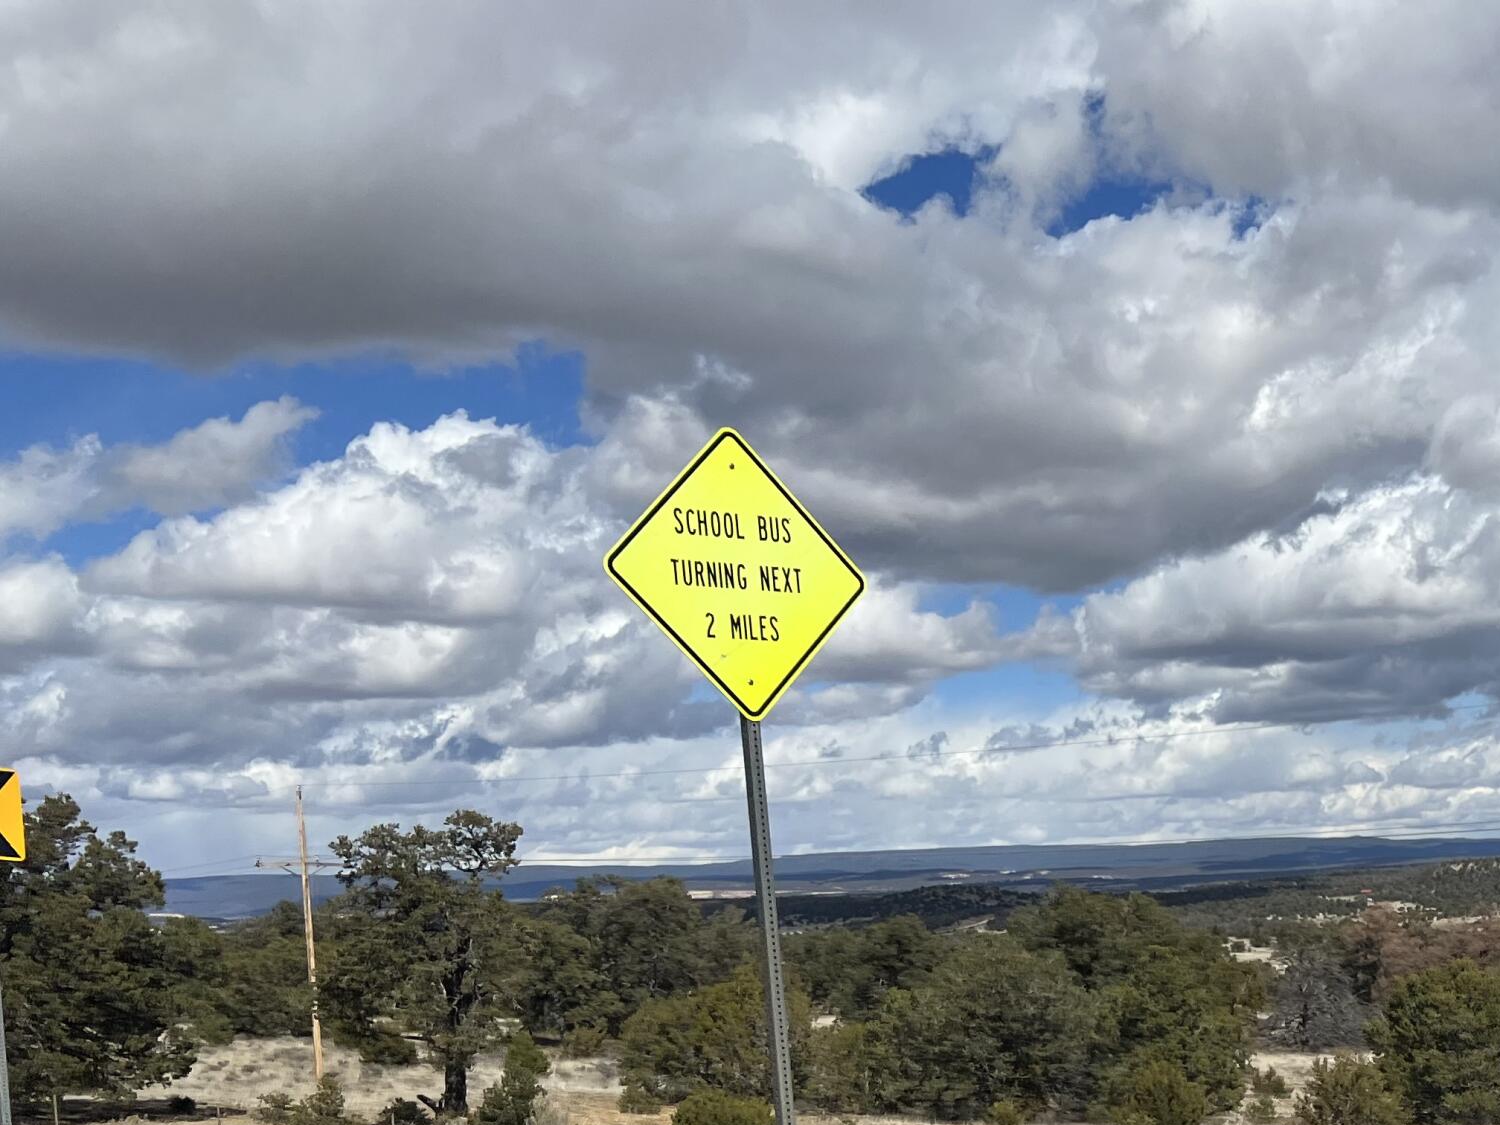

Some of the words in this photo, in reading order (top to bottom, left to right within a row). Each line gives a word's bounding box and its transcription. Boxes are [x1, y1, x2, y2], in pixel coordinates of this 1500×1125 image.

[673, 507, 745, 540] SCHOOL
[757, 515, 792, 543] BUS
[670, 558, 747, 590] TURNING
[759, 565, 801, 594] NEXT
[705, 612, 716, 639] 2
[729, 613, 780, 642] MILES
